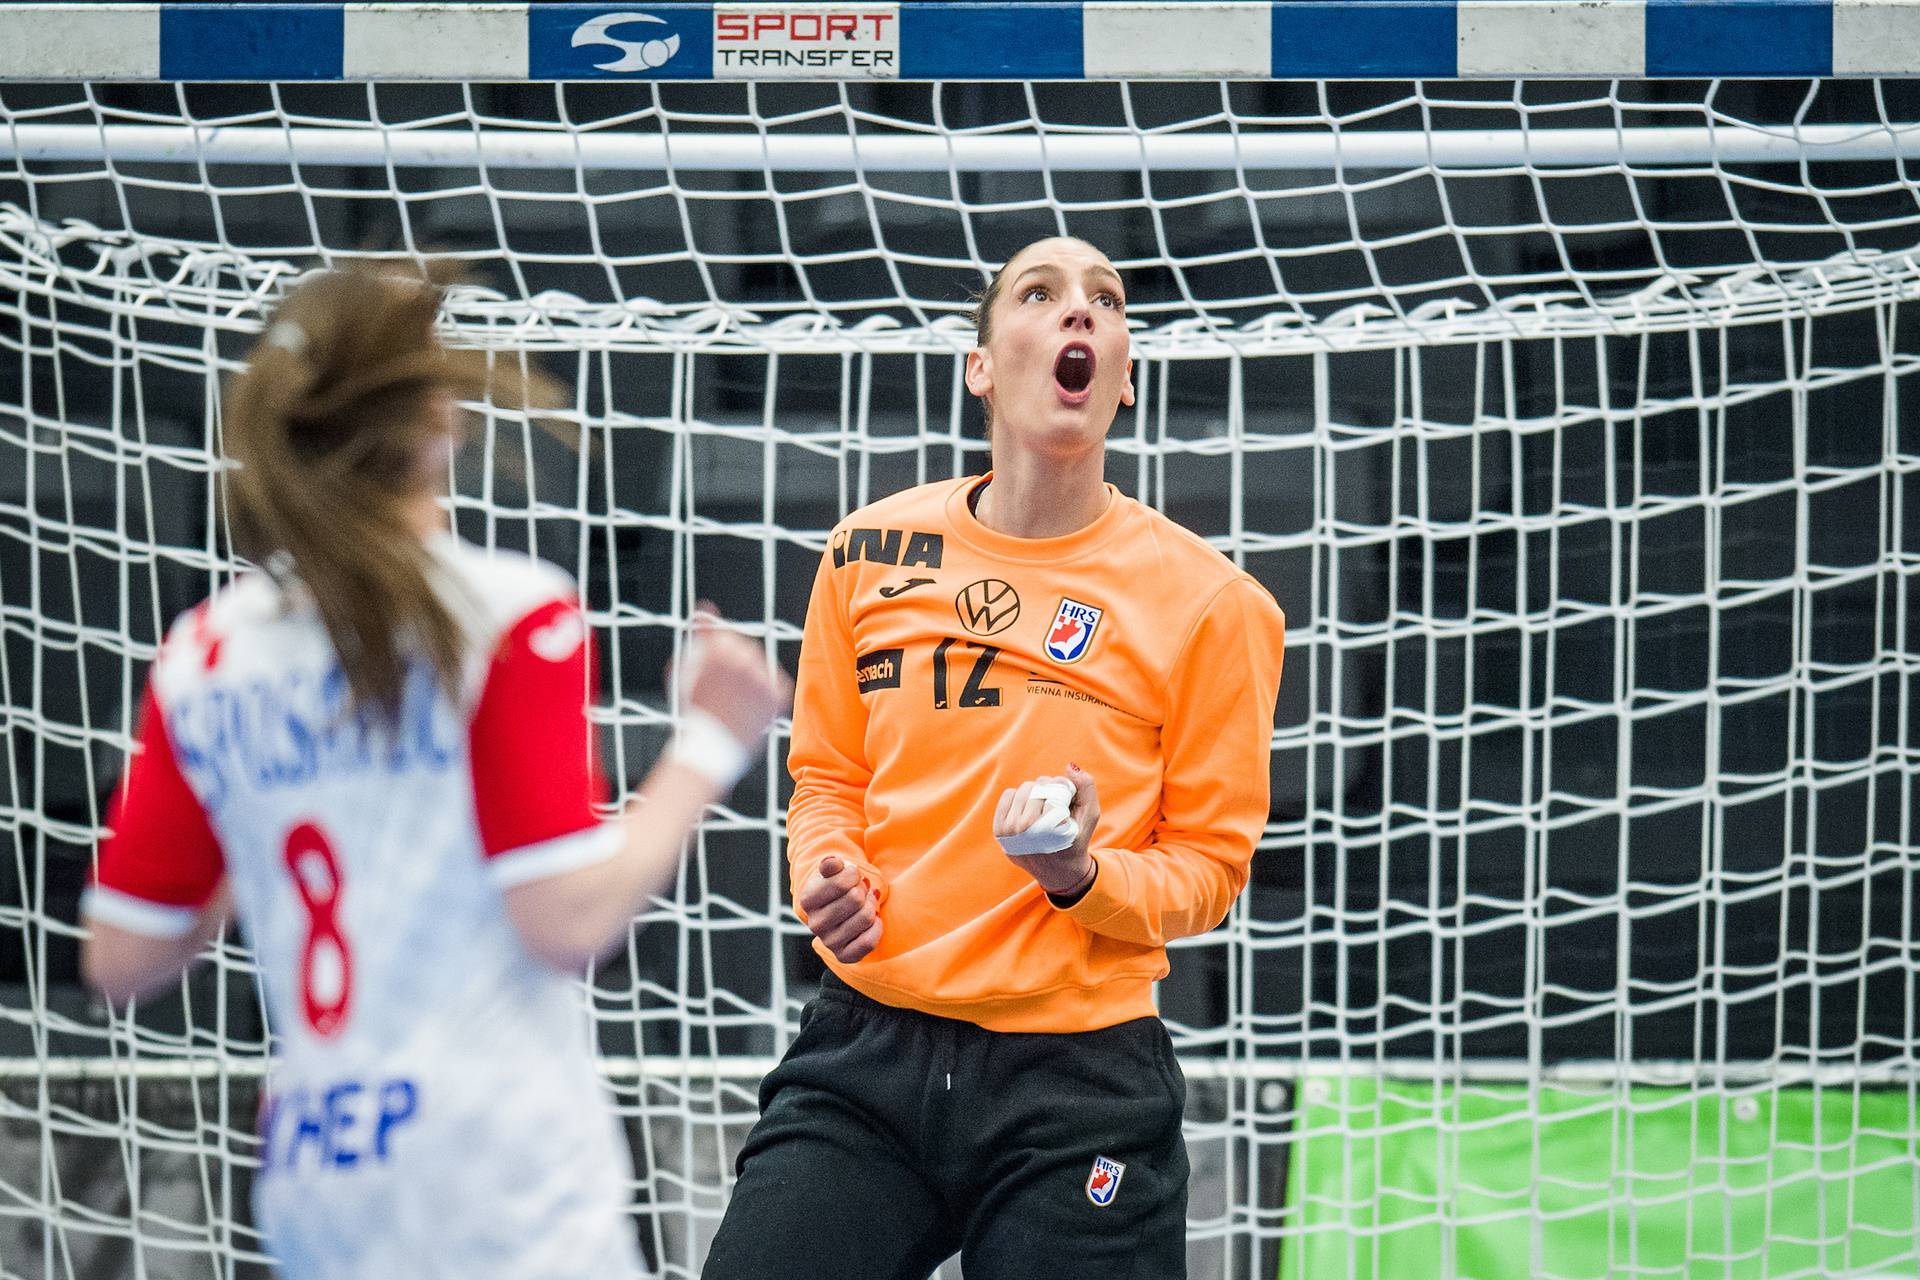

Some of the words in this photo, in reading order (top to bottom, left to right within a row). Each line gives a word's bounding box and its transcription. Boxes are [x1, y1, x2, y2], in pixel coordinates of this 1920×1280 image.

[717, 14, 894, 41] SPORT
[717, 49, 894, 67] TRANSFER
[1061, 603, 1098, 624] HRS
[932, 637, 1002, 709] 12
[1026, 685, 1062, 698] VIENNA
[284, 820, 353, 1041] 8
[1096, 1157, 1121, 1176] HRS
